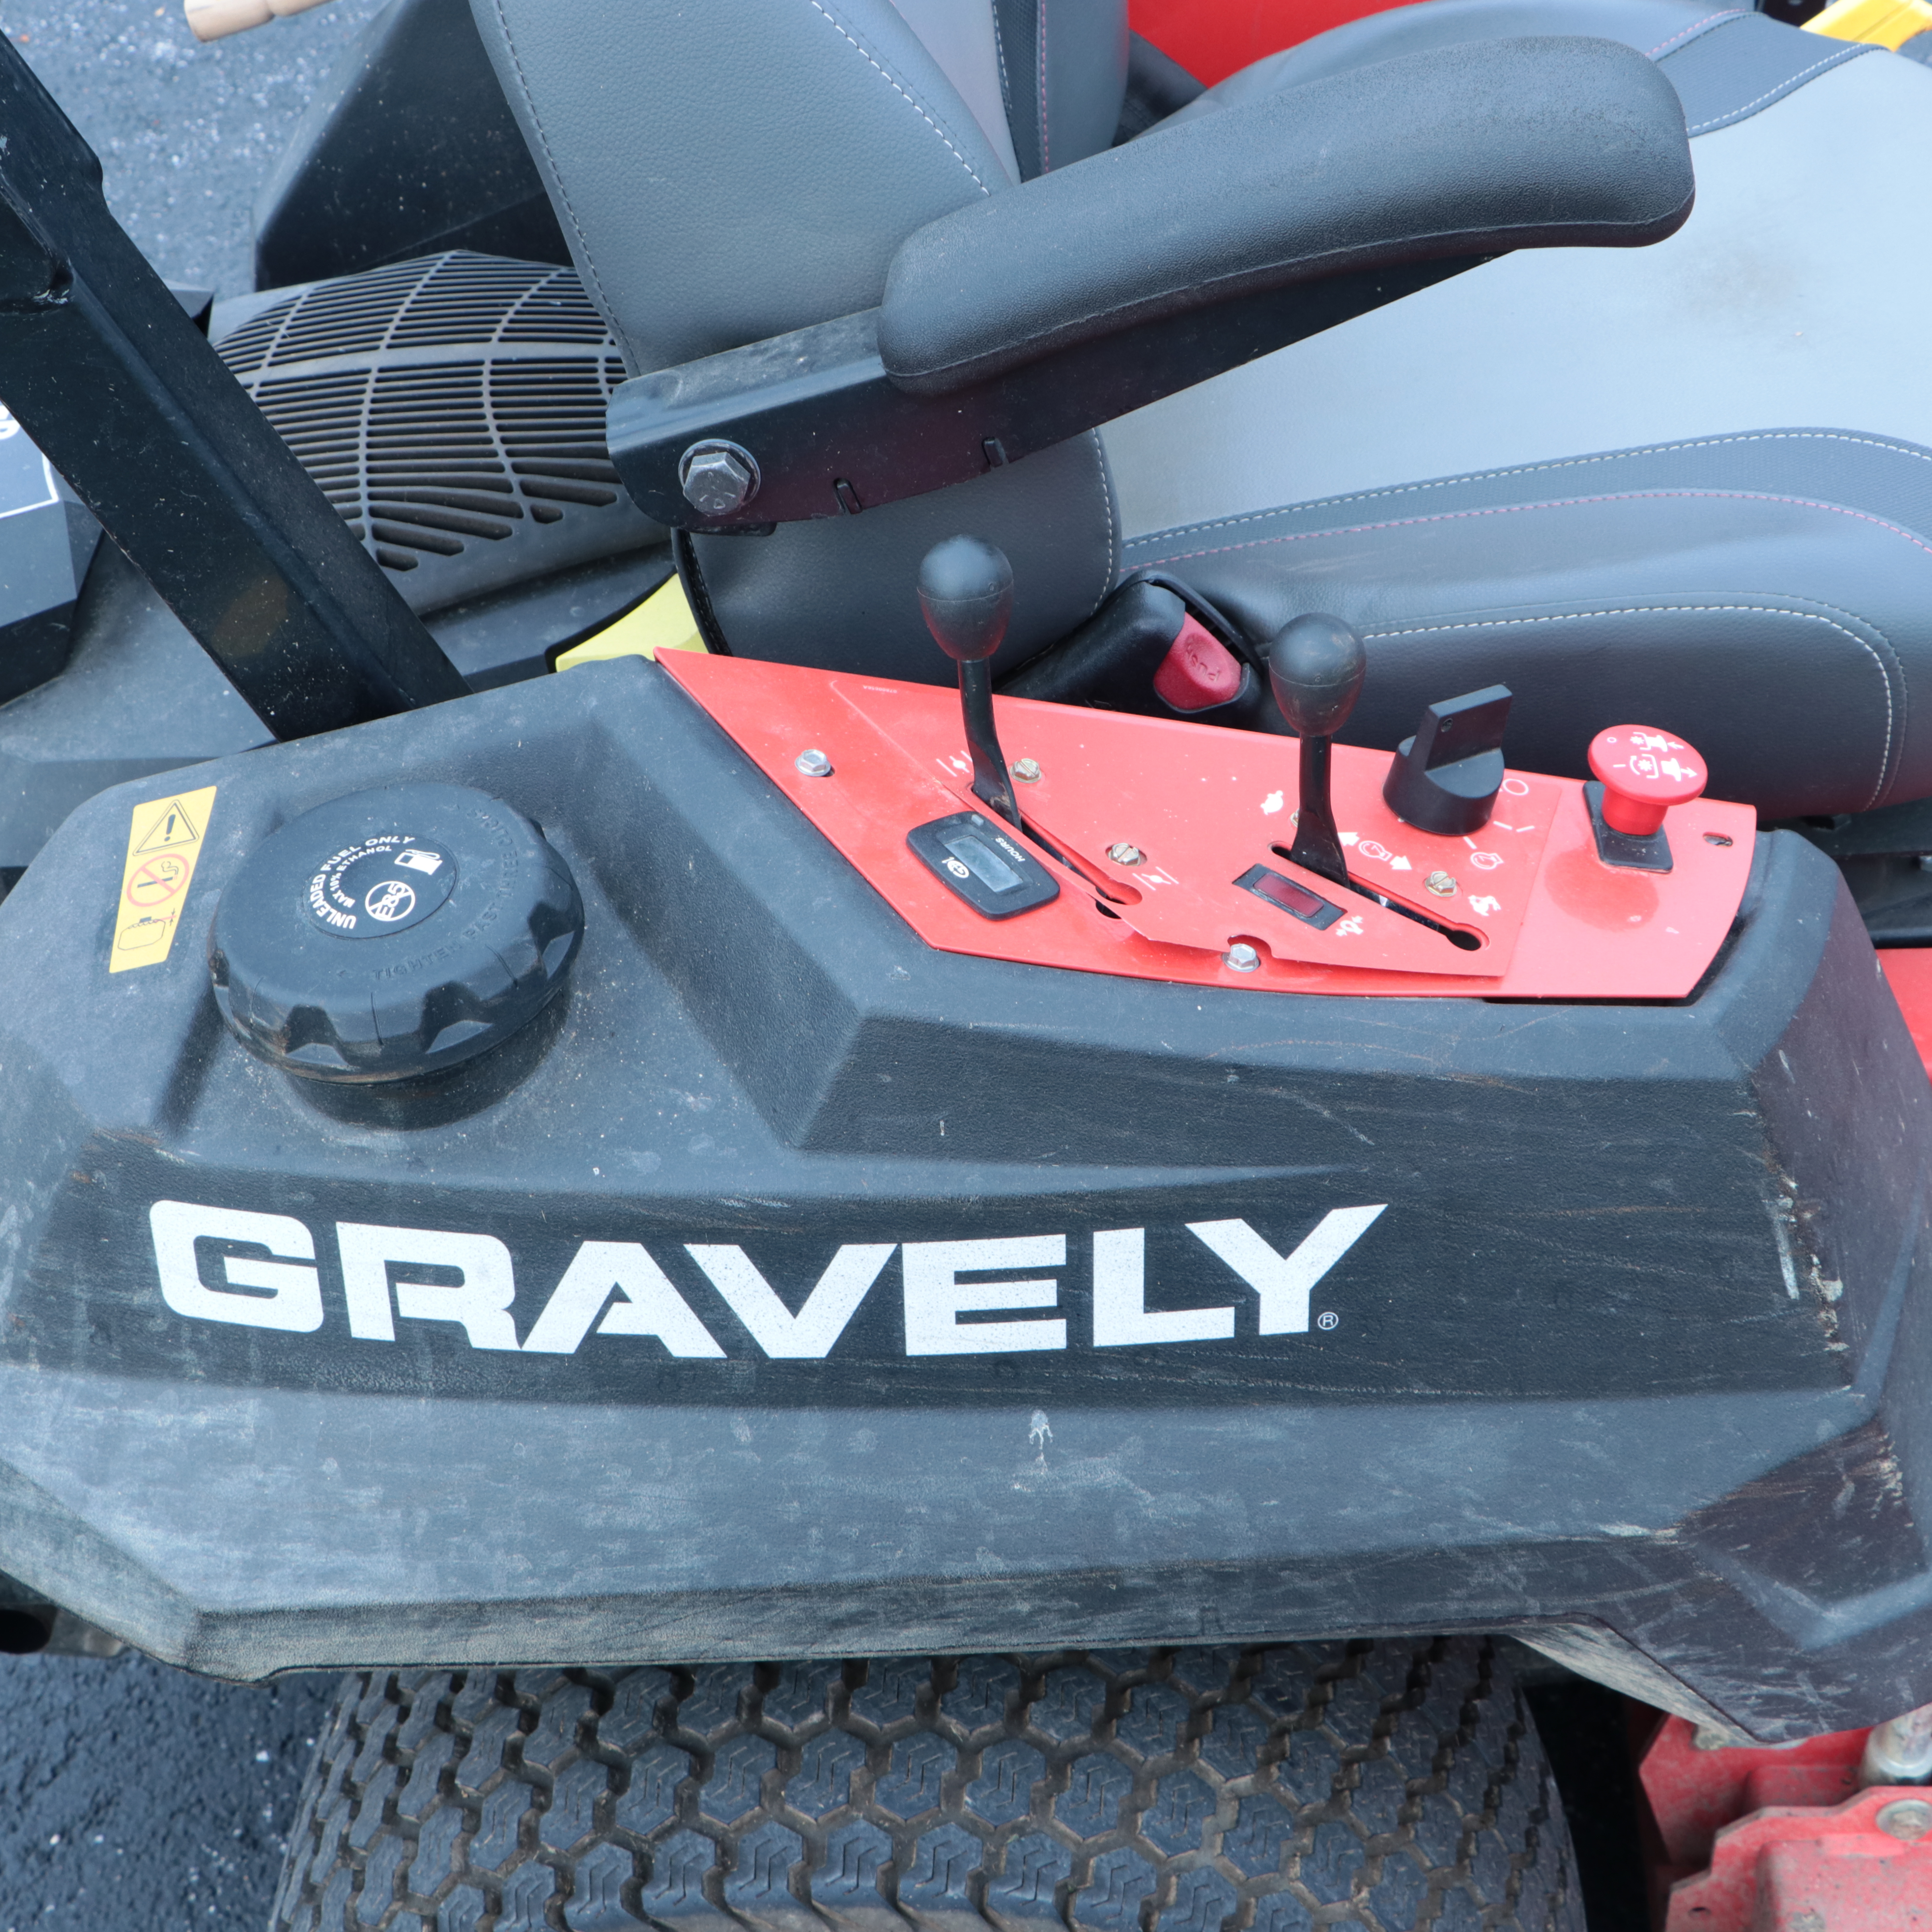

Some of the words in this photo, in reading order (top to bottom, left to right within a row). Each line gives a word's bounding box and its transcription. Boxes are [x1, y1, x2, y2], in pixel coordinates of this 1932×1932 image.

[365, 836, 415, 846] ONLY
[995, 837, 1025, 862] HOURS
[320, 846, 361, 871] FUEL
[336, 845, 392, 871] ETHANOL
[330, 872, 341, 891] 10%
[310, 874, 356, 929] UNLEADED
[332, 890, 355, 908] MAX
[376, 883, 406, 919] E85
[373, 942, 462, 980] TIGHTEN
[149, 1202, 1388, 1359] GRAVELY
